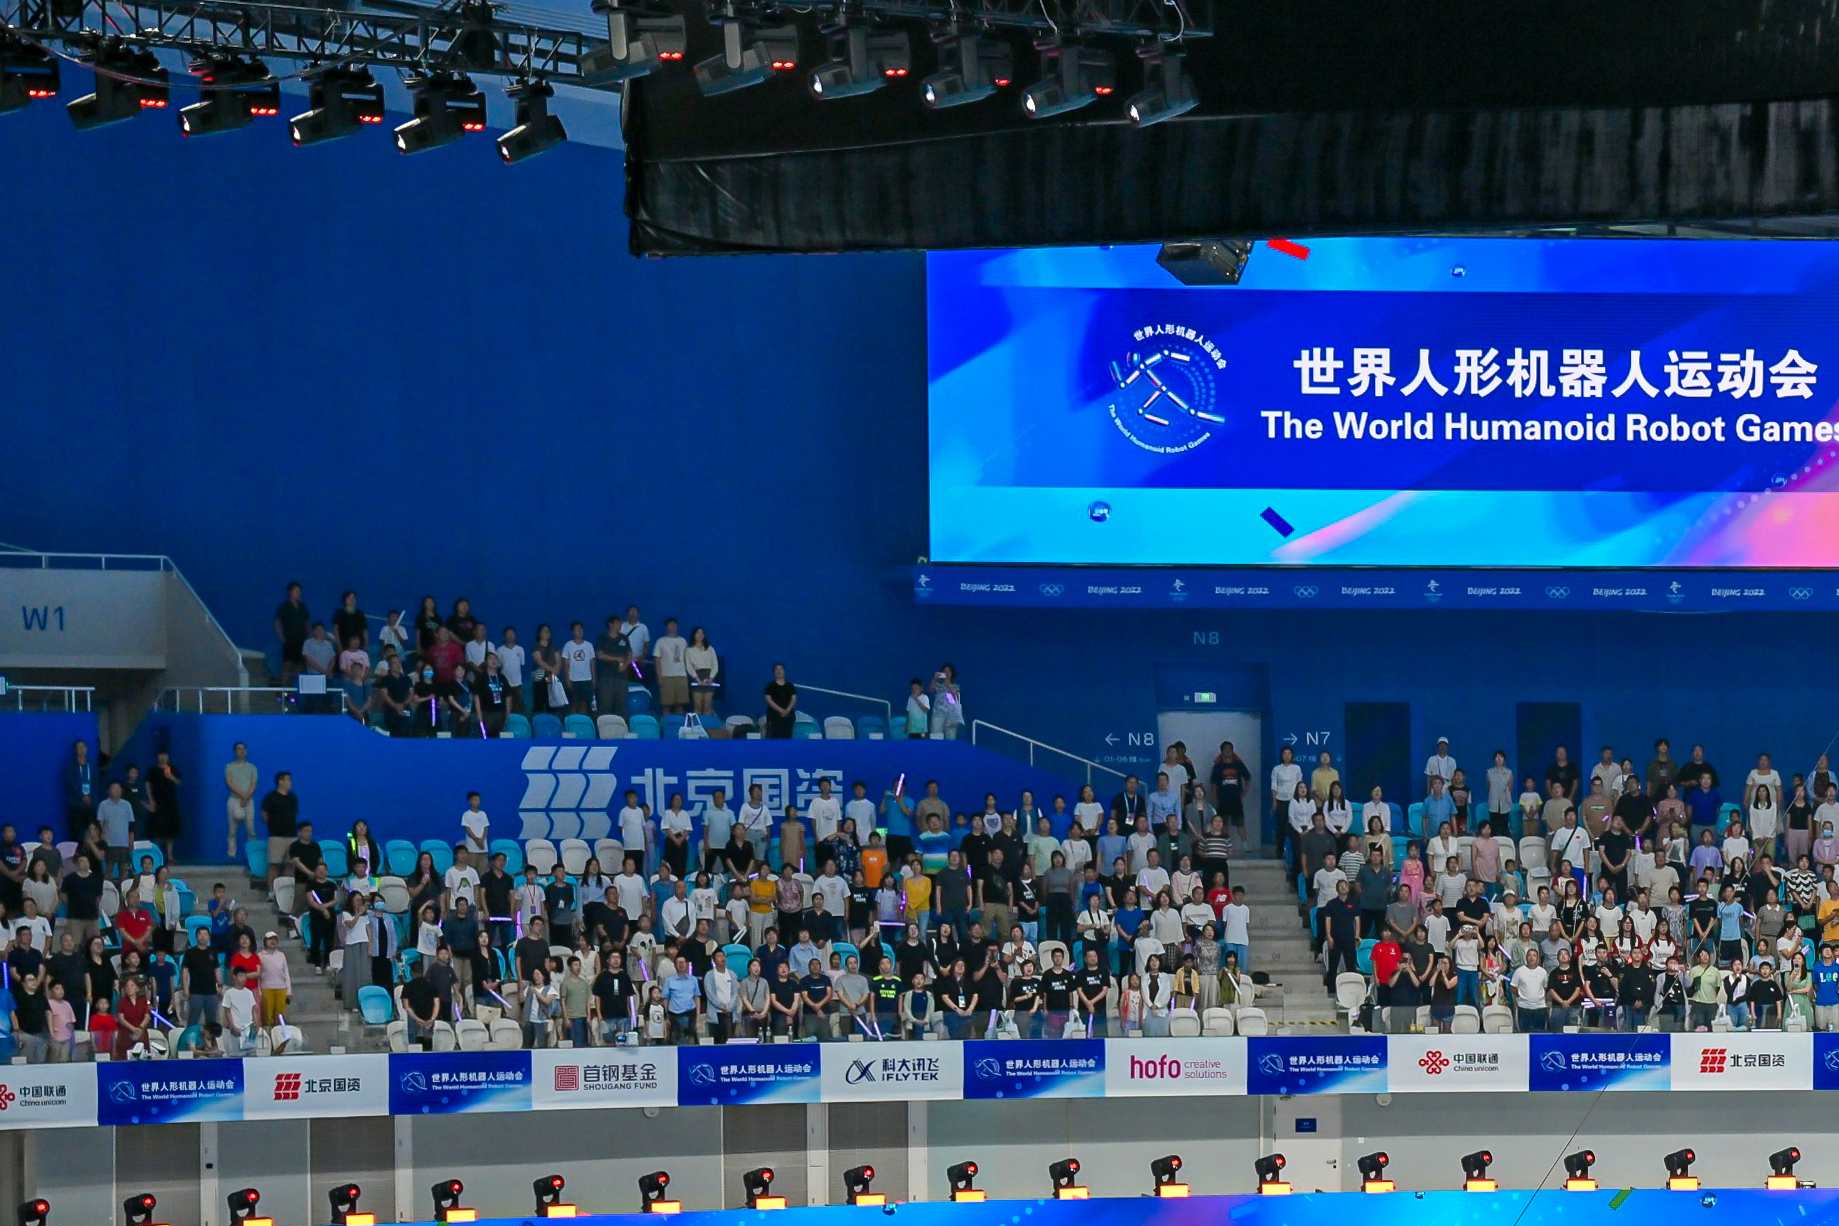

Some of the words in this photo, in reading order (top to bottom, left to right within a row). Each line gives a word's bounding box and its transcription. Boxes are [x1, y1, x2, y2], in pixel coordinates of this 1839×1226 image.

[1293, 347, 1818, 399] 世界人形机器人运动会
[1261, 411, 1322, 439] The
[1333, 411, 1432, 441] World
[1445, 412, 1615, 442] Humanoid
[1627, 413, 1725, 442] Robot
[961, 583, 990, 593] BEIJING
[993, 584, 1016, 592] 2022
[1088, 586, 1118, 595] BEIJING
[1120, 586, 1142, 594] 2022
[1215, 586, 1244, 595] BEIJING
[1247, 586, 1270, 594] 2022
[1341, 586, 1370, 595] BEIJING
[1373, 586, 1396, 594] 2022
[1467, 587, 1497, 596] BEIJING
[1499, 587, 1522, 595] 2022
[1593, 587, 1623, 597] BEIJING
[1625, 587, 1647, 595] 2022
[1711, 587, 1741, 597] BEIJING
[1744, 587, 1765, 596] 2022
[22, 606, 65, 631] W1
[1193, 631, 1220, 646] N8
[1128, 732, 1154, 746] N8
[1306, 732, 1331, 745] N7
[1290, 1056, 1379, 1066] 世界人形机器人运动会
[1454, 1053, 1499, 1064] 中国联通
[1571, 1053, 1661, 1062] 世界人形机器人运动会
[1730, 1054, 1785, 1067] 北京国资
[882, 1058, 939, 1072] 科大讯飞
[1006, 1058, 1096, 1069] 世界人形机器人运动会
[1130, 1055, 1182, 1079] hofo
[1185, 1060, 1221, 1069] creative
[584, 1064, 657, 1082] 首钢基金
[721, 1064, 812, 1075] 世界人形机器人运动会
[1184, 1070, 1227, 1079] solutions
[432, 1072, 524, 1083] 世界人形机器人运动会
[141, 1080, 234, 1093] 世界人形机器人运动会
[305, 1078, 361, 1093] 北京国资
[584, 1083, 632, 1091] SHOUGANG
[635, 1081, 657, 1089] FUND
[19, 1085, 67, 1098] 中国联通
